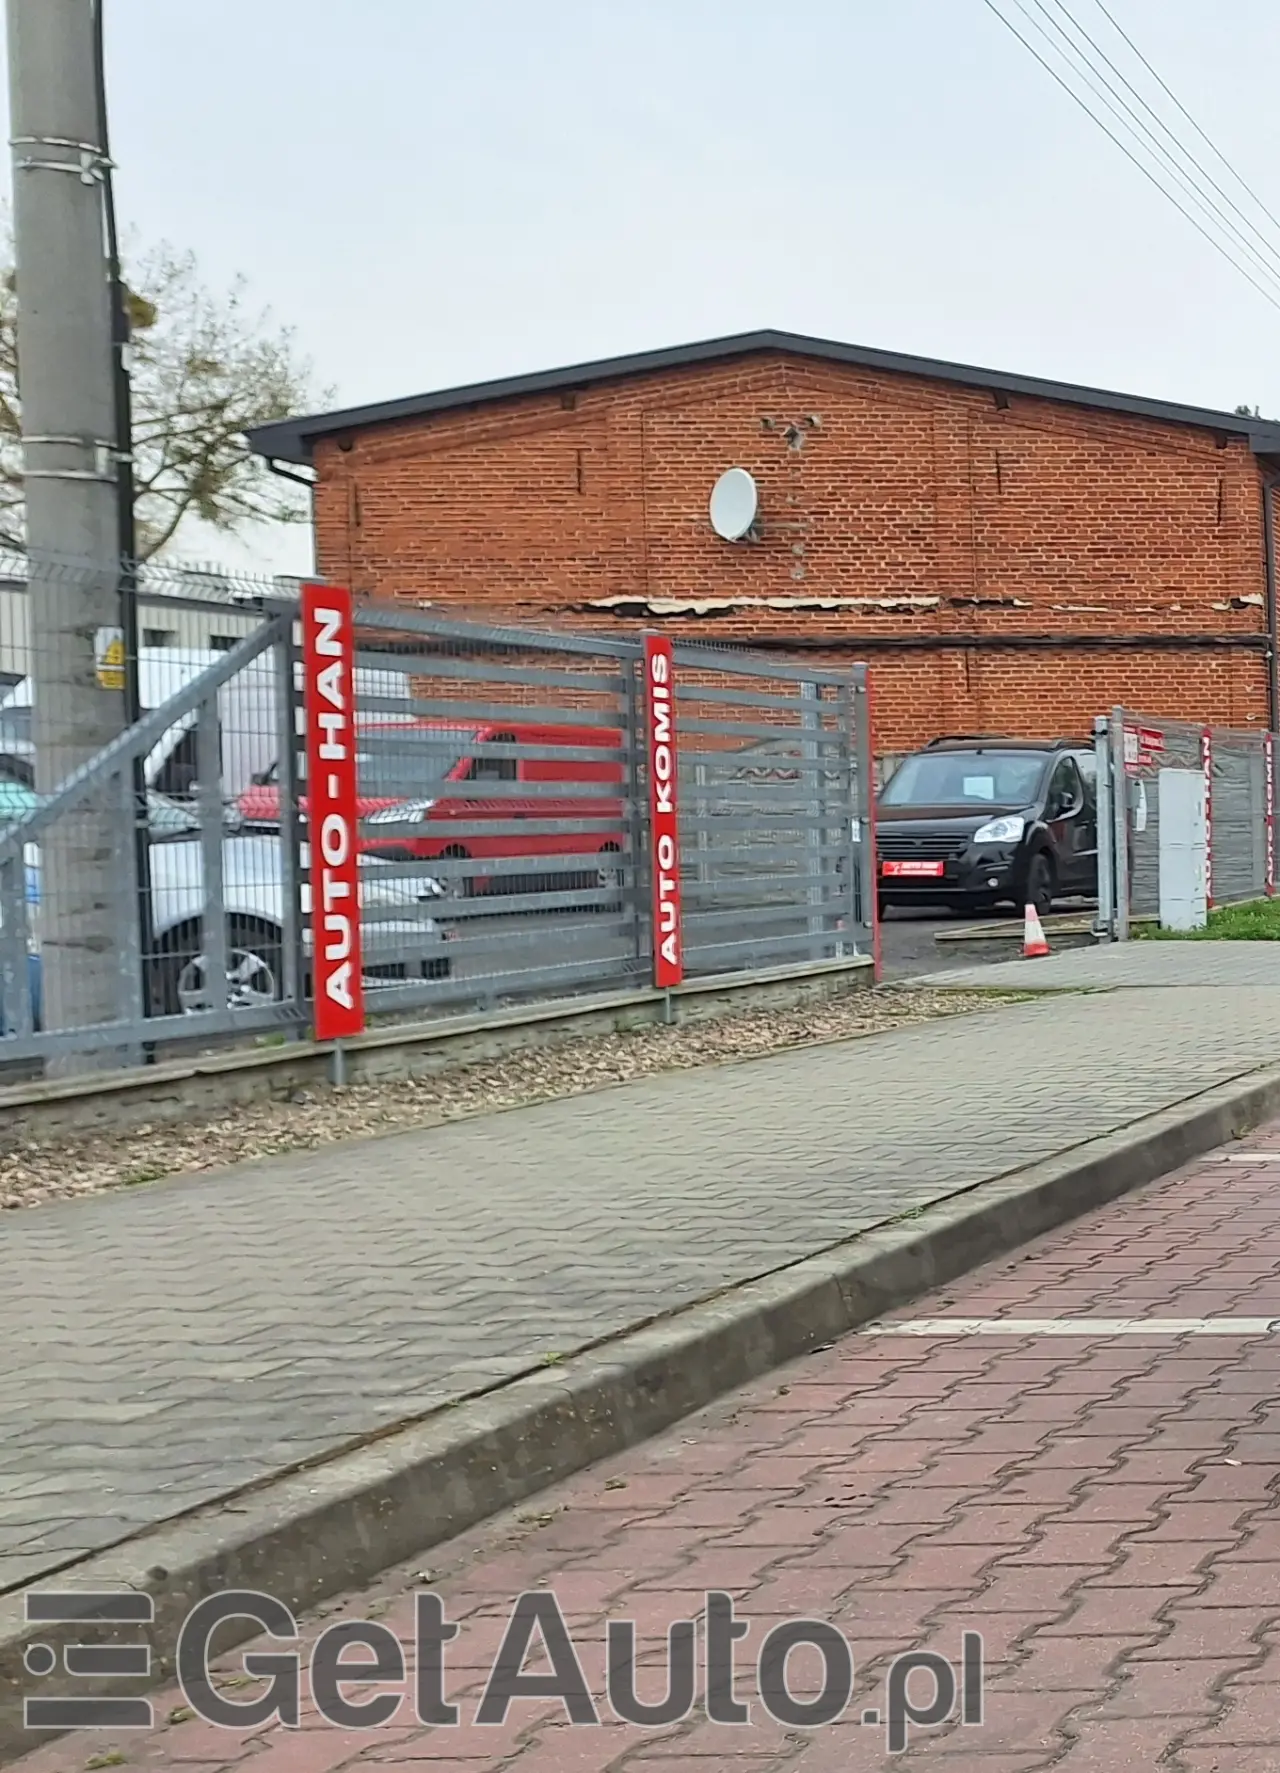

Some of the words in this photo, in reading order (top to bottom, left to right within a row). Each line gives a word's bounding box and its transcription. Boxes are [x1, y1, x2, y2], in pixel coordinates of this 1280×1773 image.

[313, 607, 348, 760] HAN
[651, 653, 674, 814] KOMIS
[321, 813, 354, 1010] AUTO
[659, 834, 677, 966] AUTO
